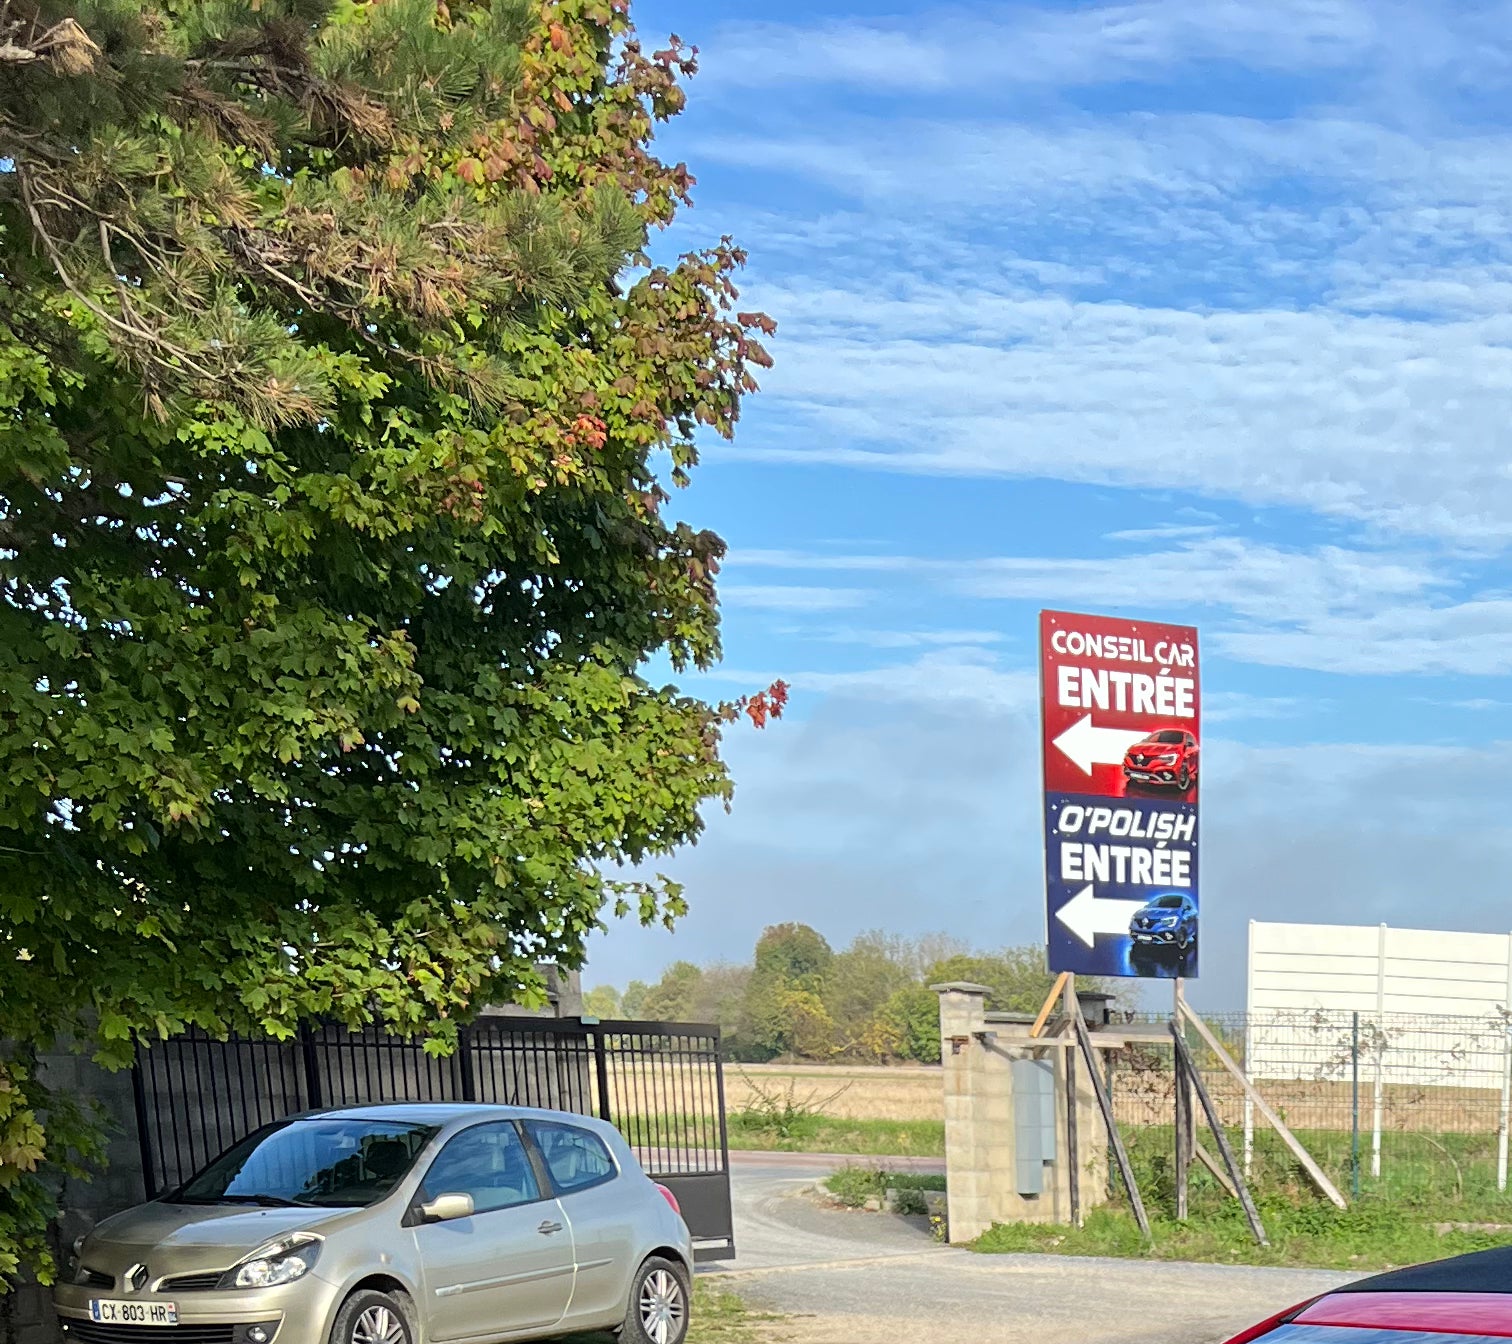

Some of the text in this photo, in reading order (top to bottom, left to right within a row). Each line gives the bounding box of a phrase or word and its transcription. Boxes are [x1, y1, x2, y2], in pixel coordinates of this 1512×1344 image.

[1051, 630, 1195, 668] CONSEIL CAR
[1057, 666, 1195, 718] ENTRÉE
[1058, 805, 1196, 842] O'POLISH
[1060, 841, 1191, 887] ENTRÉE
